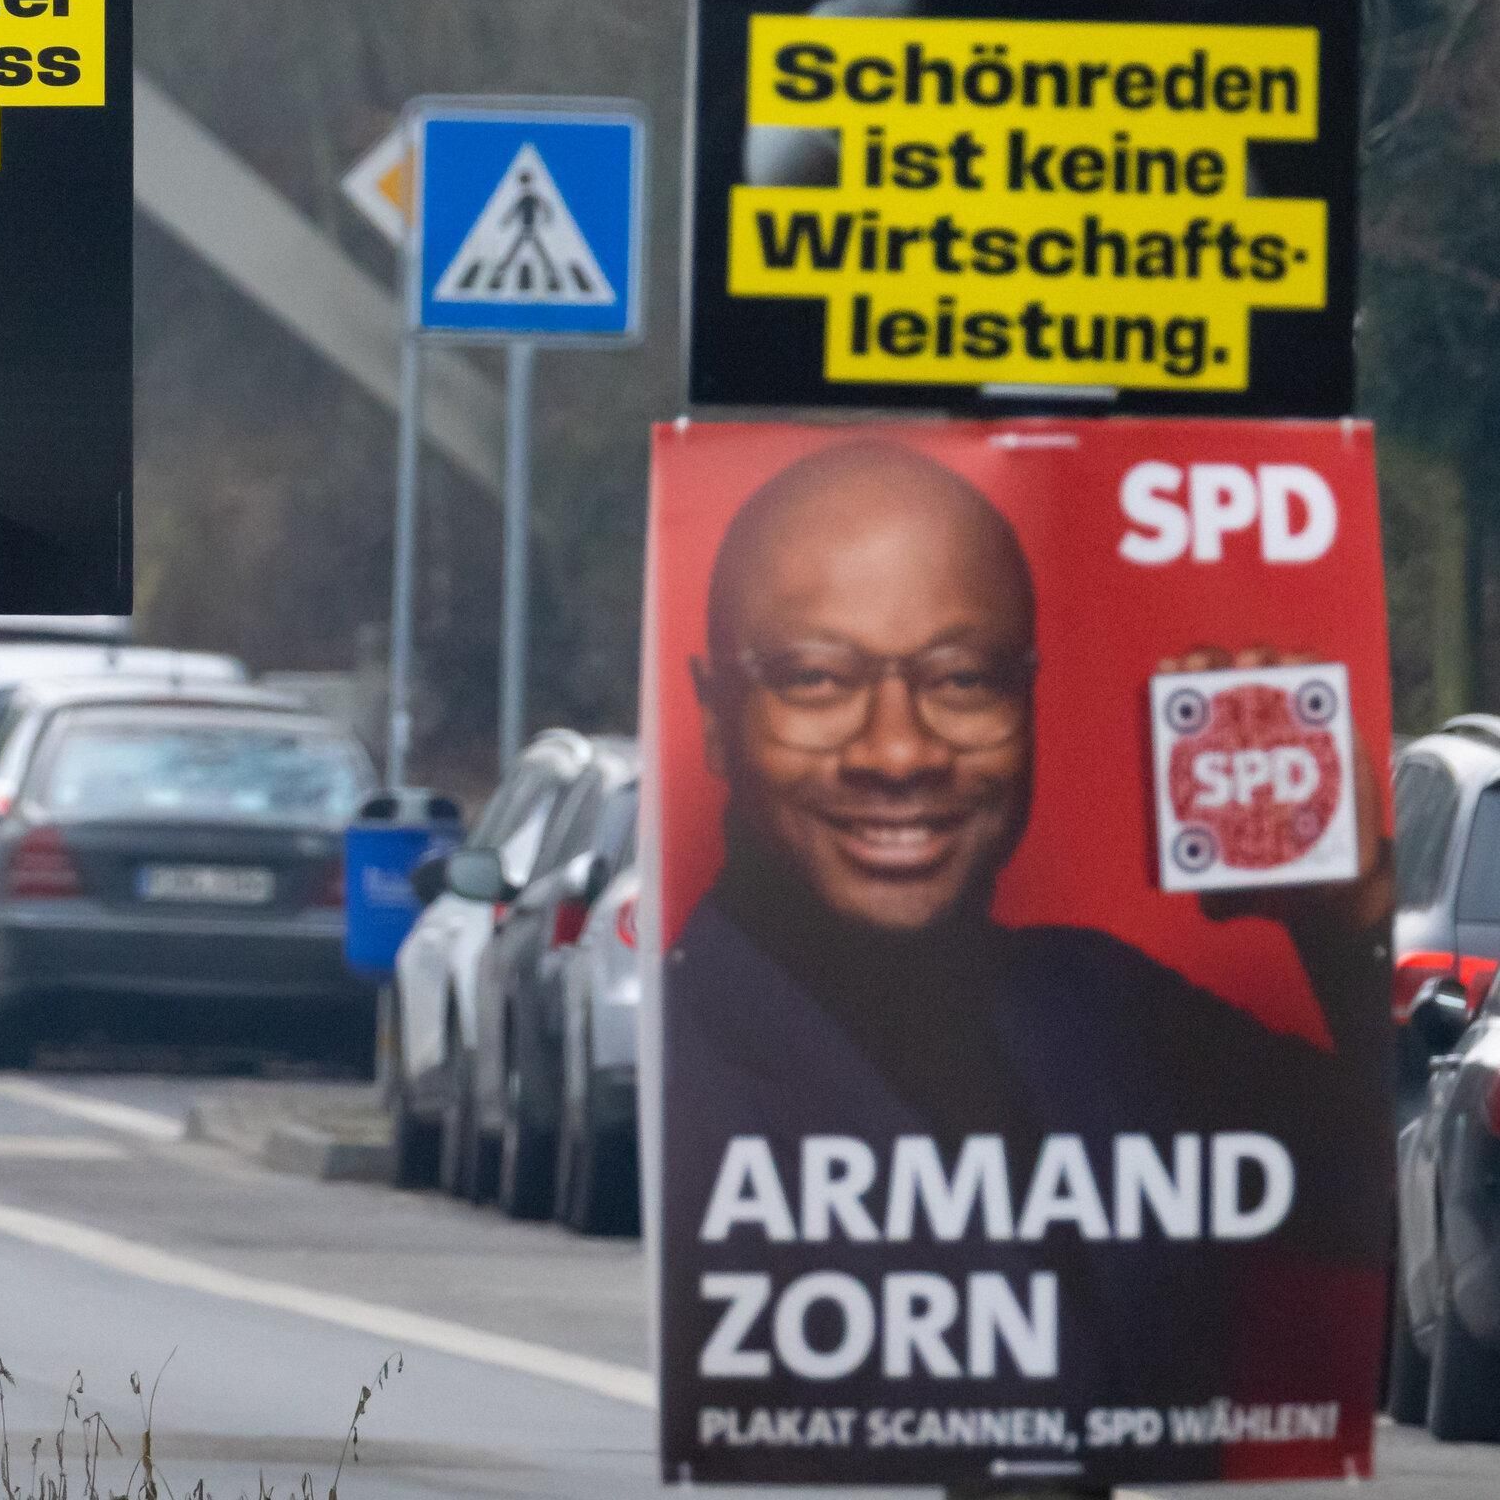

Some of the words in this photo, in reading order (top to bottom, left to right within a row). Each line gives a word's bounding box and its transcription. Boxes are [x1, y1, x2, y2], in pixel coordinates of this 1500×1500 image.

[772, 42, 1299, 114] Schönreden
[864, 126, 985, 190] ist
[1007, 128, 1226, 196] keine
[754, 210, 1308, 283] Wirtschafts-
[849, 295, 1228, 378] leistung.
[1117, 461, 1337, 564] SPD
[1192, 746, 1321, 809] SPD
[700, 1132, 1296, 1241] ARMAND
[700, 1270, 1059, 1379] ZORN
[702, 1409, 857, 1446] PLAKAT
[866, 1408, 1078, 1451] SCANNEN,
[1084, 1407, 1160, 1445] SPD
[1167, 1397, 1339, 1444] WÄHLEN!
